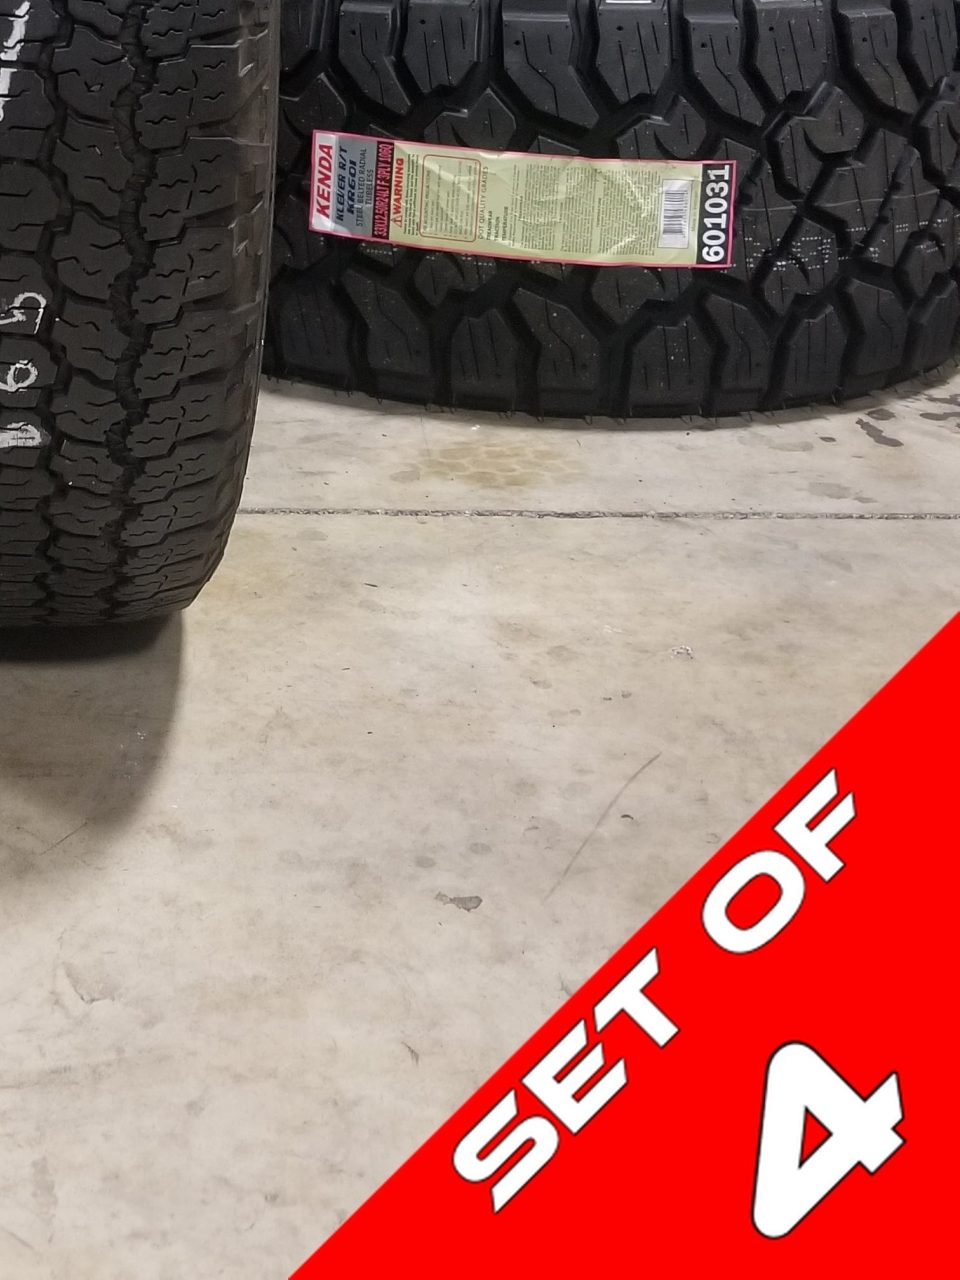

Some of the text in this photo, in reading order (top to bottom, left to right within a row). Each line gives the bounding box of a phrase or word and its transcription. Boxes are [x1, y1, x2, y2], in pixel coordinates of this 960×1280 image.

[316, 144, 332, 218] KENDA
[336, 145, 347, 221] KLEVER R/T
[357, 176, 365, 203] BELTED
[365, 169, 373, 205] TUBELESS
[392, 158, 404, 215] WARNING
[702, 165, 729, 263] 601031
